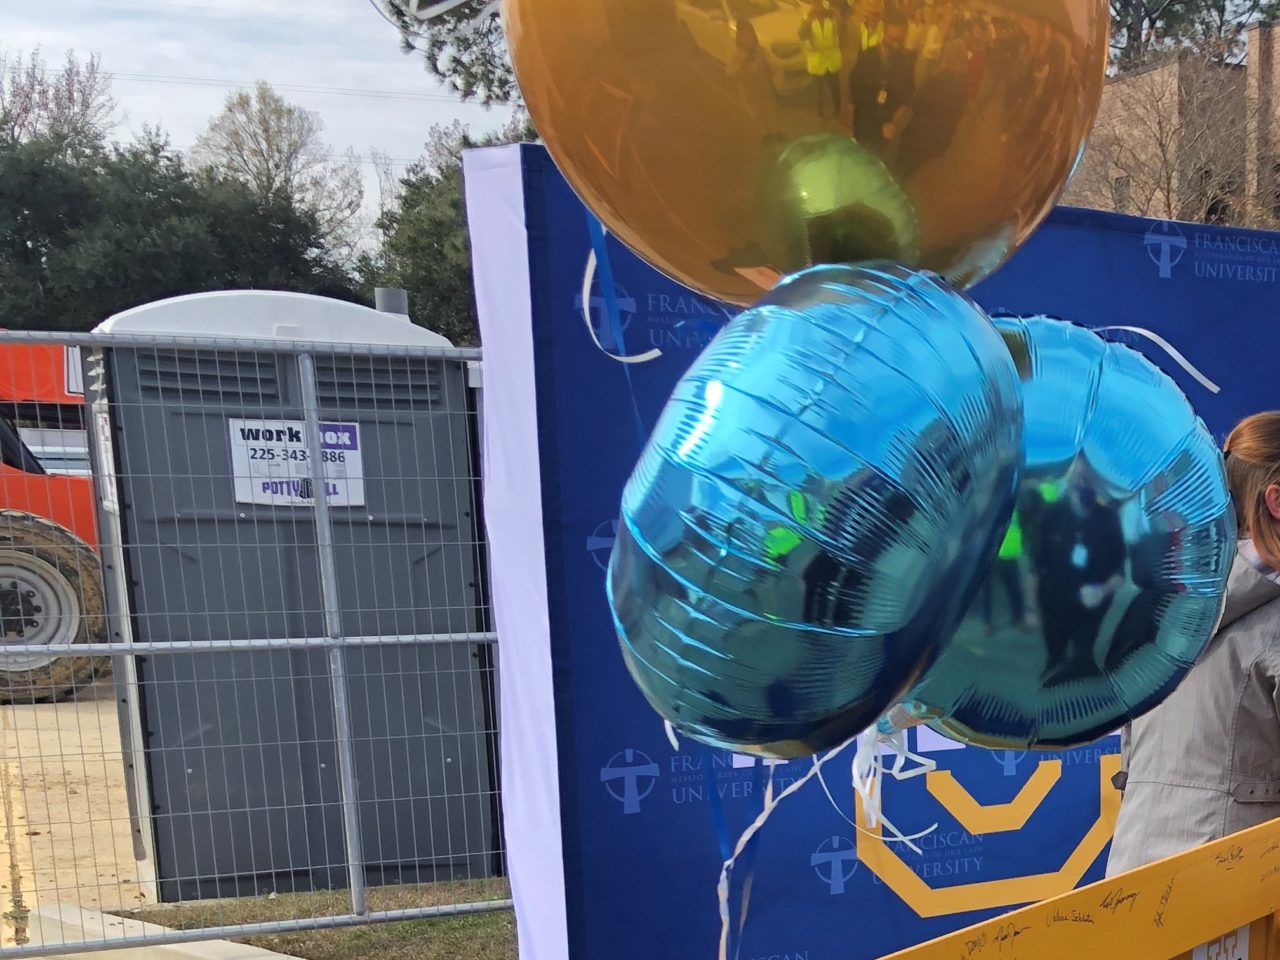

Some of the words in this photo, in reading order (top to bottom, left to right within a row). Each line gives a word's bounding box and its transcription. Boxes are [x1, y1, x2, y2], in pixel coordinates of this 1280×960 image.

[240, 427, 302, 443] work
[250, 447, 345, 463] 225-343-886
[262, 480, 300, 497] POTTY
